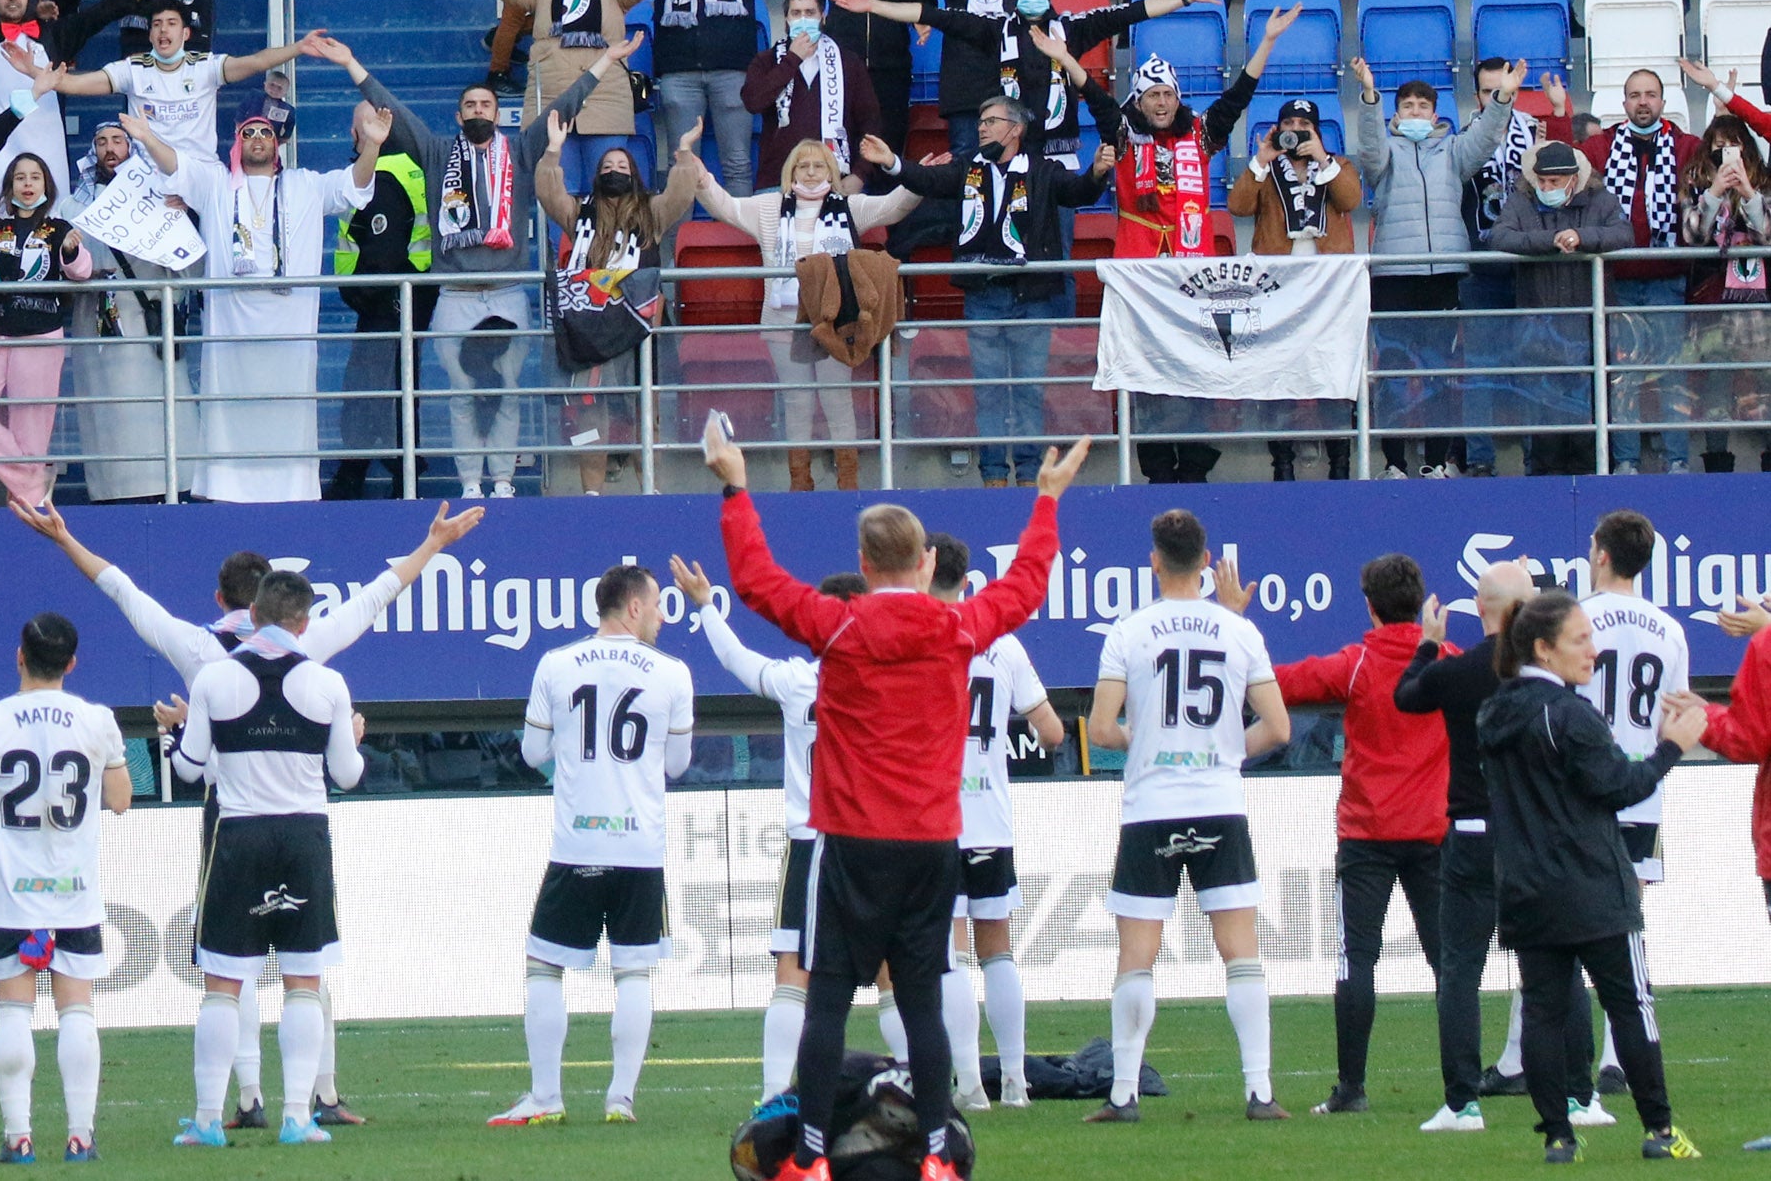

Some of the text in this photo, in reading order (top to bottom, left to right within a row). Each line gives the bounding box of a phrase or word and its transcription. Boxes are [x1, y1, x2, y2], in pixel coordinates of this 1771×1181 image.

[159, 102, 199, 113] REALE
[159, 113, 199, 121] SEGUROS
[510, 110, 520, 123] 5
[827, 100, 838, 125] TUS
[102, 224, 129, 244] 30
[1179, 263, 1281, 298] BURGOS C.F.
[1259, 572, 1332, 622] 0,0
[1150, 615, 1220, 640] ALEGRÍA
[1591, 609, 1667, 641] CÓRDOBA
[1152, 647, 1227, 730] 15
[1593, 649, 1665, 731] 18
[14, 706, 75, 729] MATOS
[568, 683, 649, 765] 16
[247, 727, 297, 736] CATAPULT
